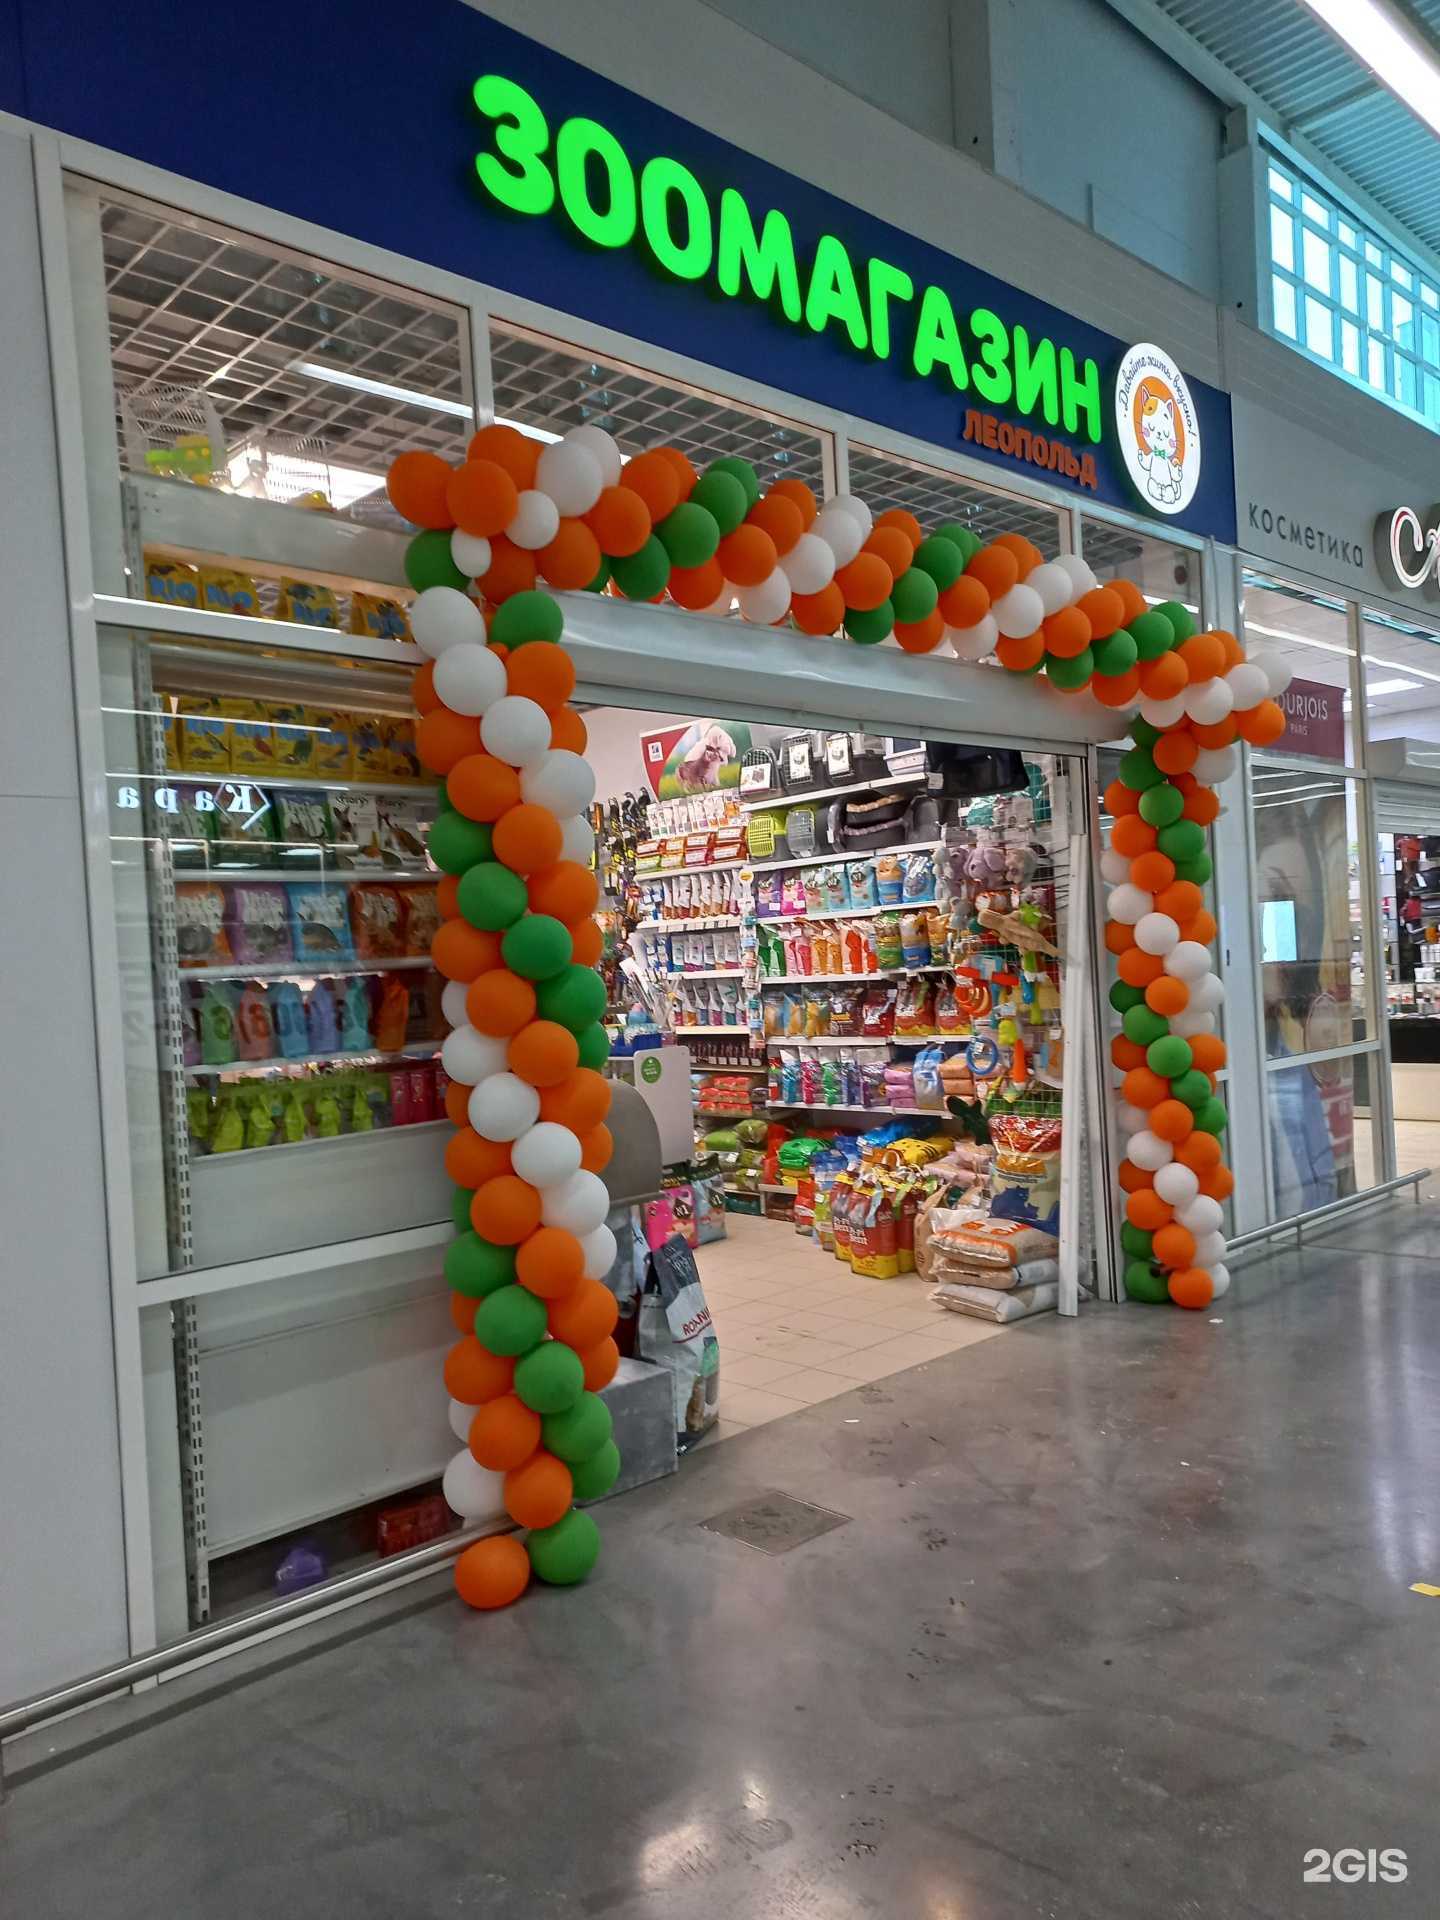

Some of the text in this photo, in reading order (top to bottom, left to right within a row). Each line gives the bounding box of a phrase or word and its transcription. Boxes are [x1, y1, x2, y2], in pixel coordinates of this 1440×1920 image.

[473, 74, 1101, 444] ЗООМАГАЗИН
[963, 409, 1098, 490] ЛЕОПОЛЬД
[1249, 502, 1364, 569] косметика
[1275, 692, 1328, 721] OURJOIS
